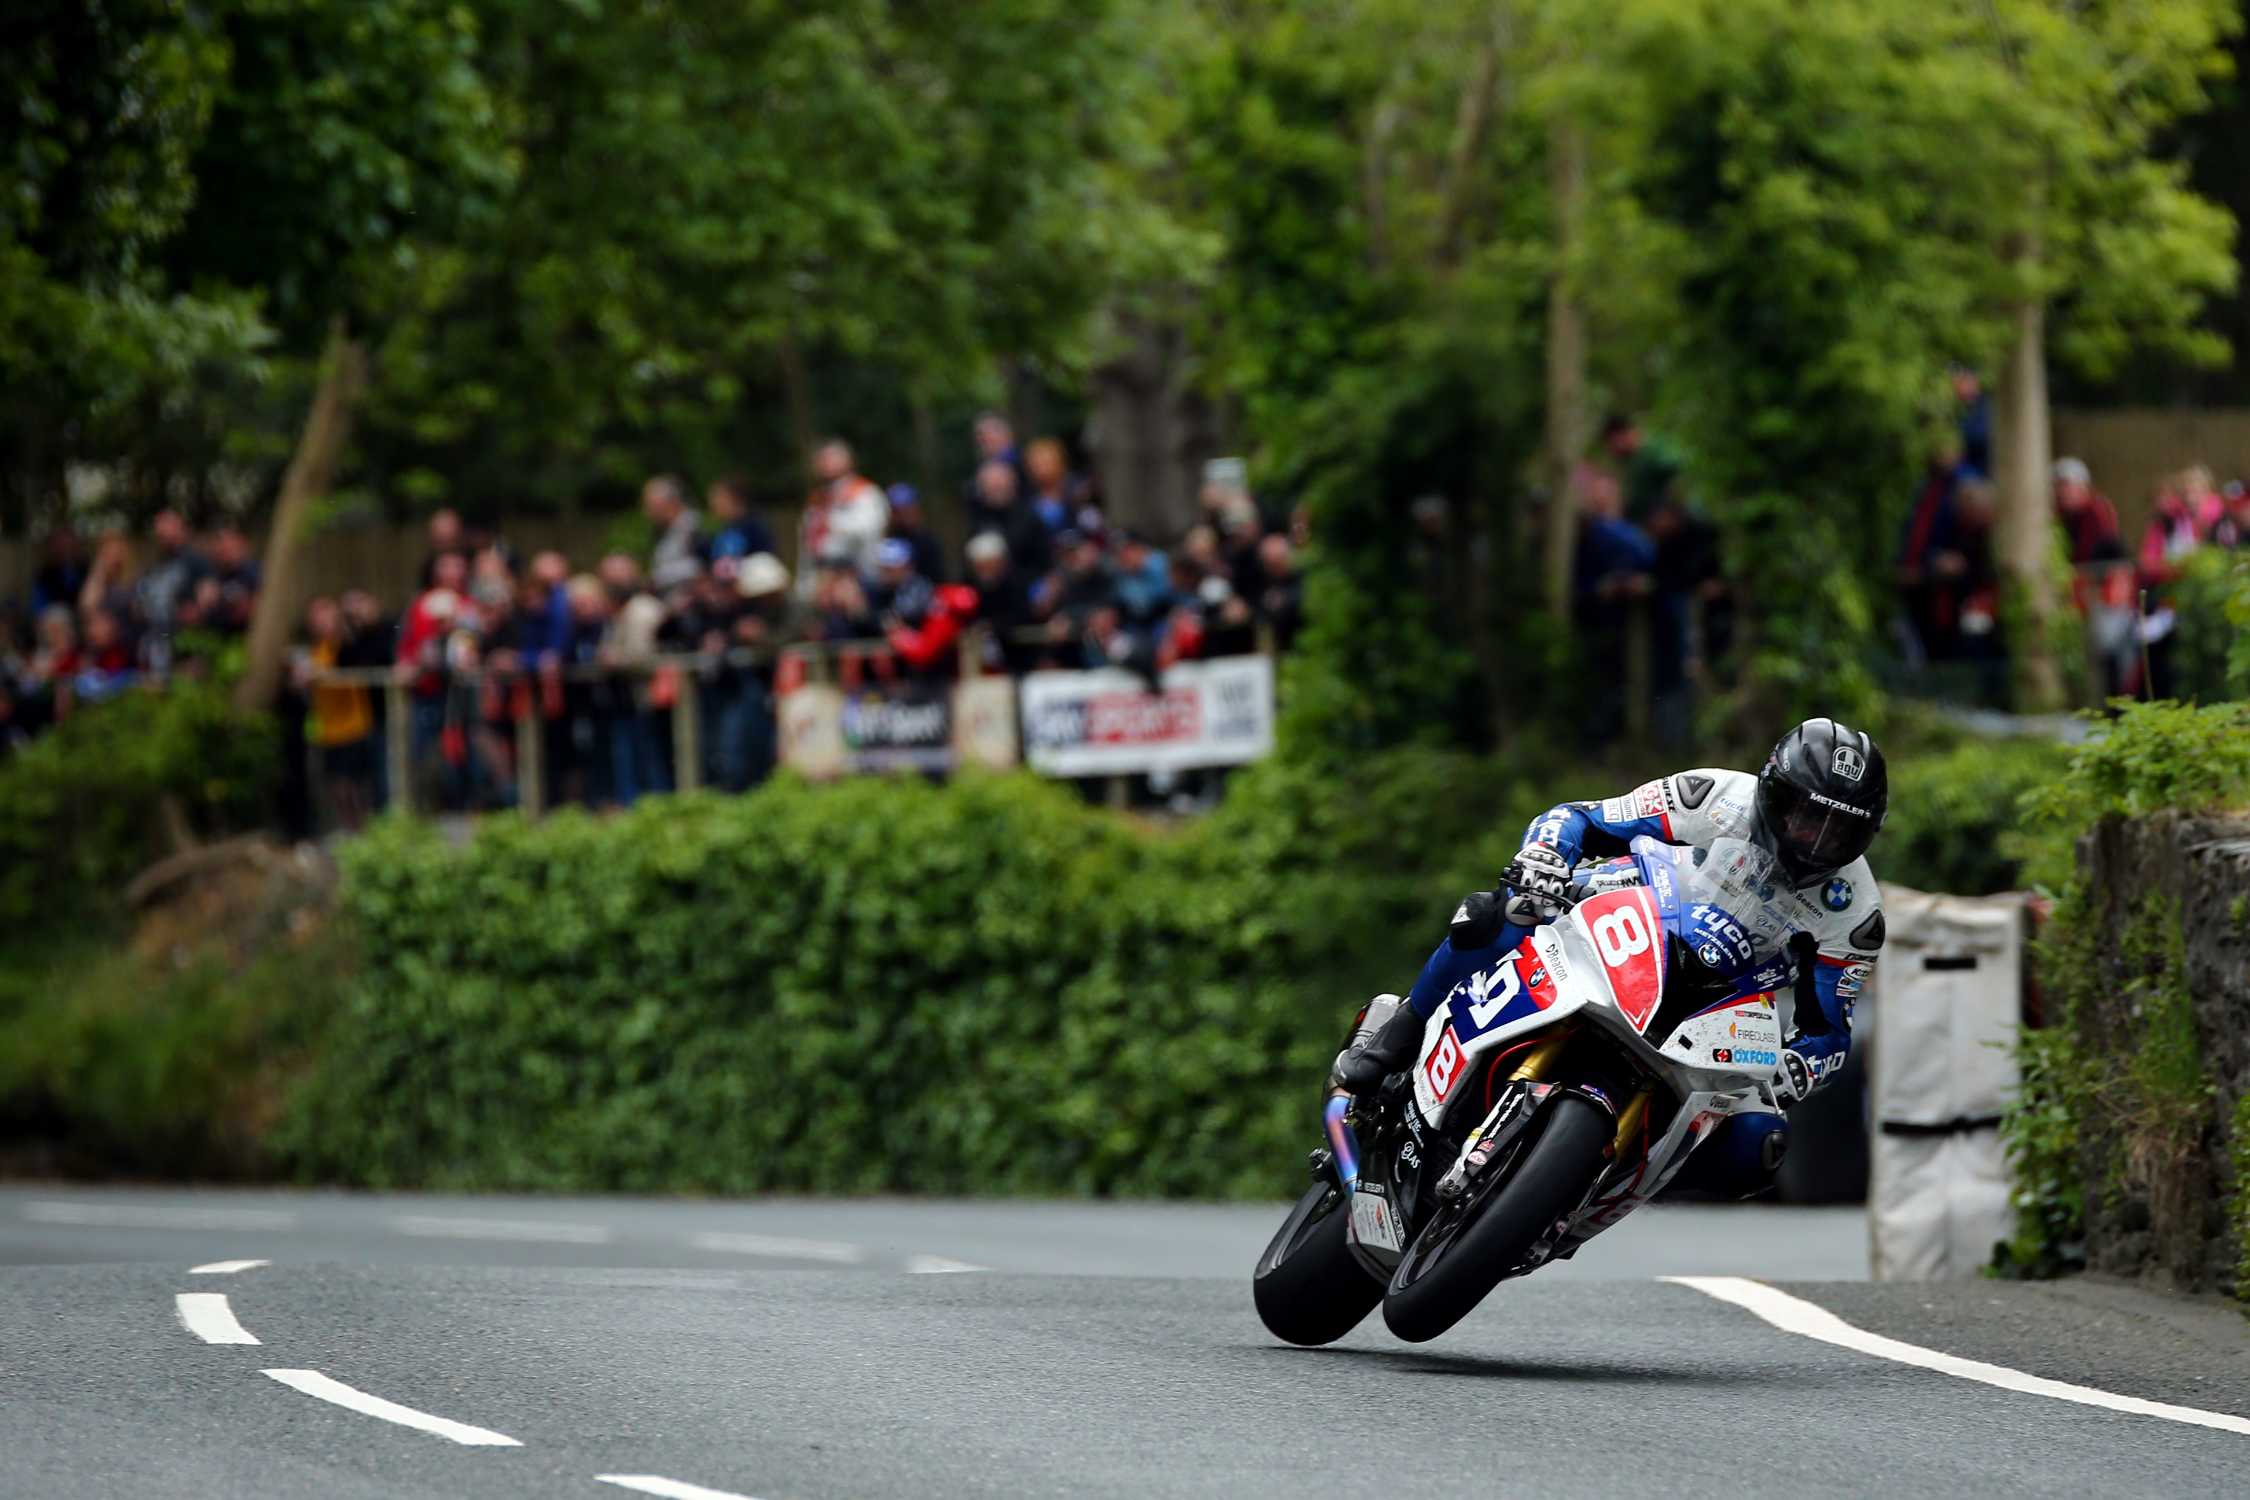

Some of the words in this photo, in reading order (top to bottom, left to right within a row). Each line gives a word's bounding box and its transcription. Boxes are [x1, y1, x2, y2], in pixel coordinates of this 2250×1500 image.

[1836, 761, 1861, 778] agv
[1810, 792, 1864, 816] METZELER
[1592, 905, 1650, 968] 8
[1691, 904, 1753, 960] tyco
[1693, 927, 1734, 960] METZELER
[1430, 1033, 1456, 1095] 8
[1733, 1048, 1777, 1066] OXFORD
